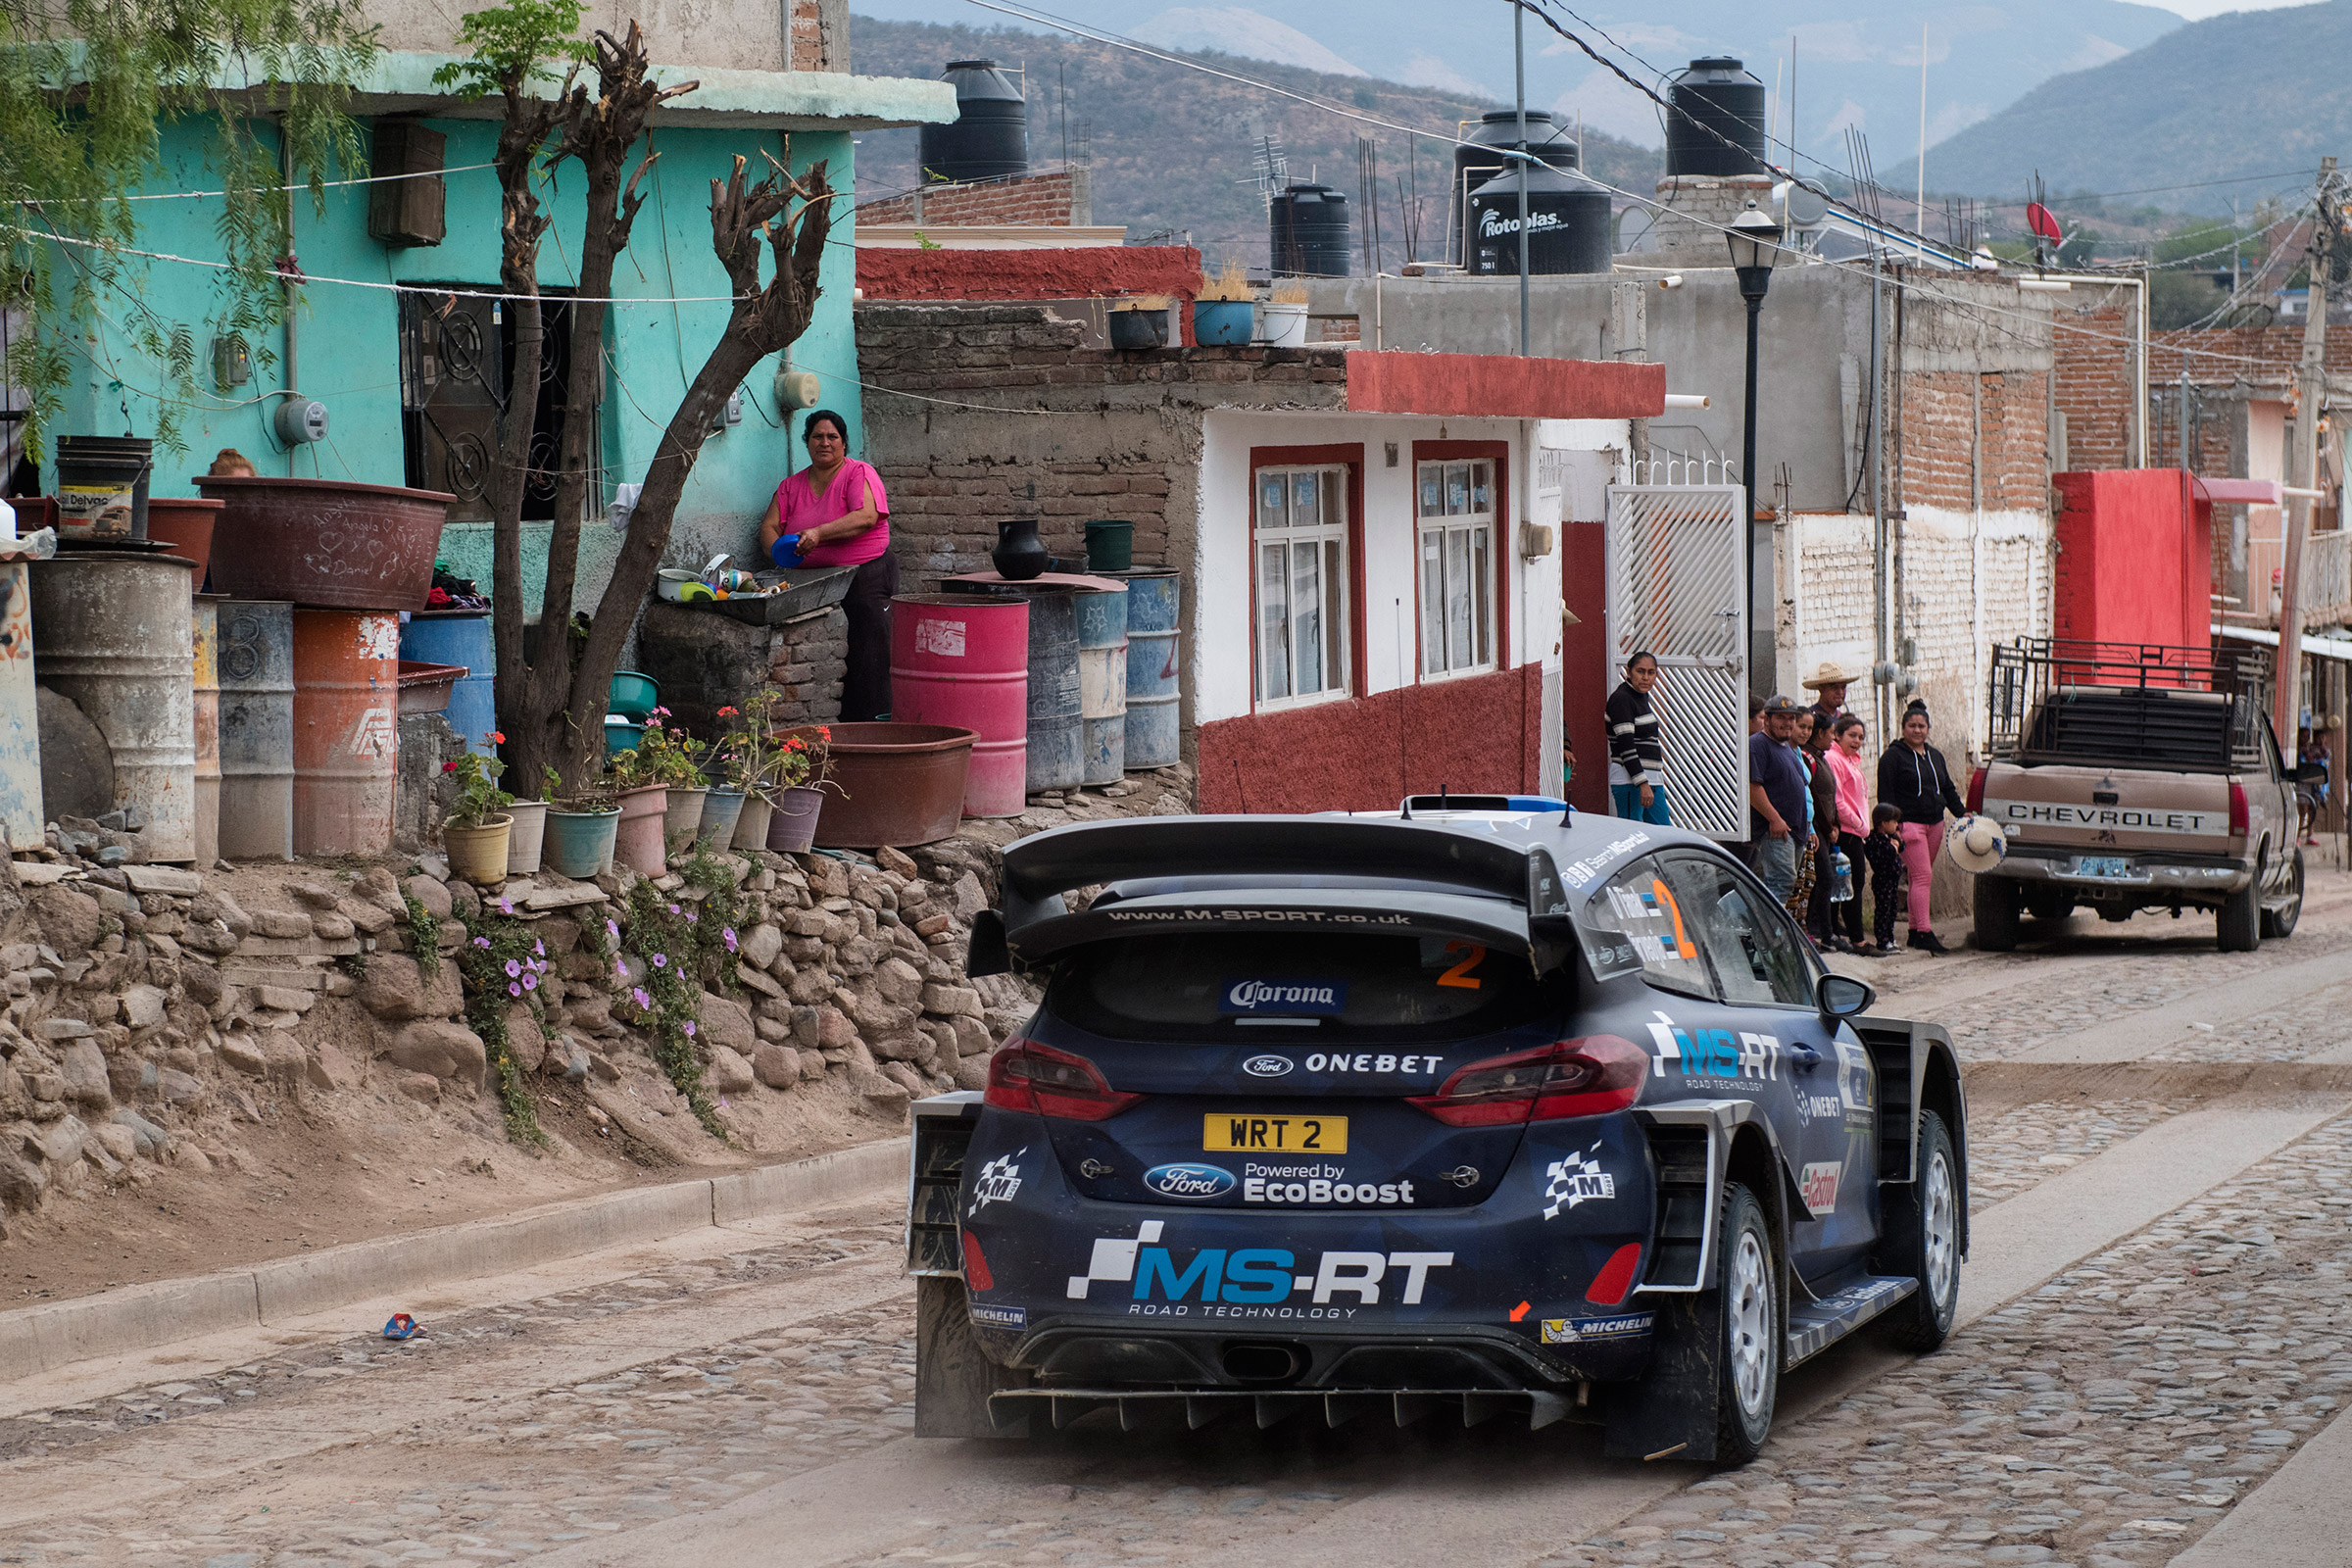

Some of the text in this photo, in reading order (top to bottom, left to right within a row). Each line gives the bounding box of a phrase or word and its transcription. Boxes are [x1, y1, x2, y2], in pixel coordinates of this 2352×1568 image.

[1486, 212, 1557, 237] Rotolas
[342, 516, 379, 538] Angela
[333, 560, 373, 575] Daniel
[2009, 805, 2205, 829] CHEVROLET
[1108, 909, 1412, 925] www.M-SPORT.co.uk
[1652, 879, 1697, 958] 2
[1436, 941, 1487, 989] 2
[1229, 980, 1335, 1008] Corona
[1305, 1053, 1445, 1075] ONEBET
[1671, 1028, 1781, 1081] MS-RT
[1686, 1079, 1764, 1092] ROAD TECHNOLOGY
[1809, 1096, 1840, 1118] ONEBET
[1230, 1118, 1321, 1149] WRT 2
[1158, 1165, 1217, 1195] Ford
[1245, 1163, 1346, 1180] Powered by
[990, 1177, 1010, 1198] M
[1244, 1178, 1414, 1203] EcoBoost
[1577, 1176, 1603, 1196] M
[1807, 1167, 1838, 1208] Castrol
[1132, 1248, 1454, 1304] MS-RT
[972, 1308, 1024, 1323] MICHELIN
[1128, 1304, 1357, 1319] ROAD TECHNOLOGY
[1581, 1316, 1653, 1335] MICHELIN
